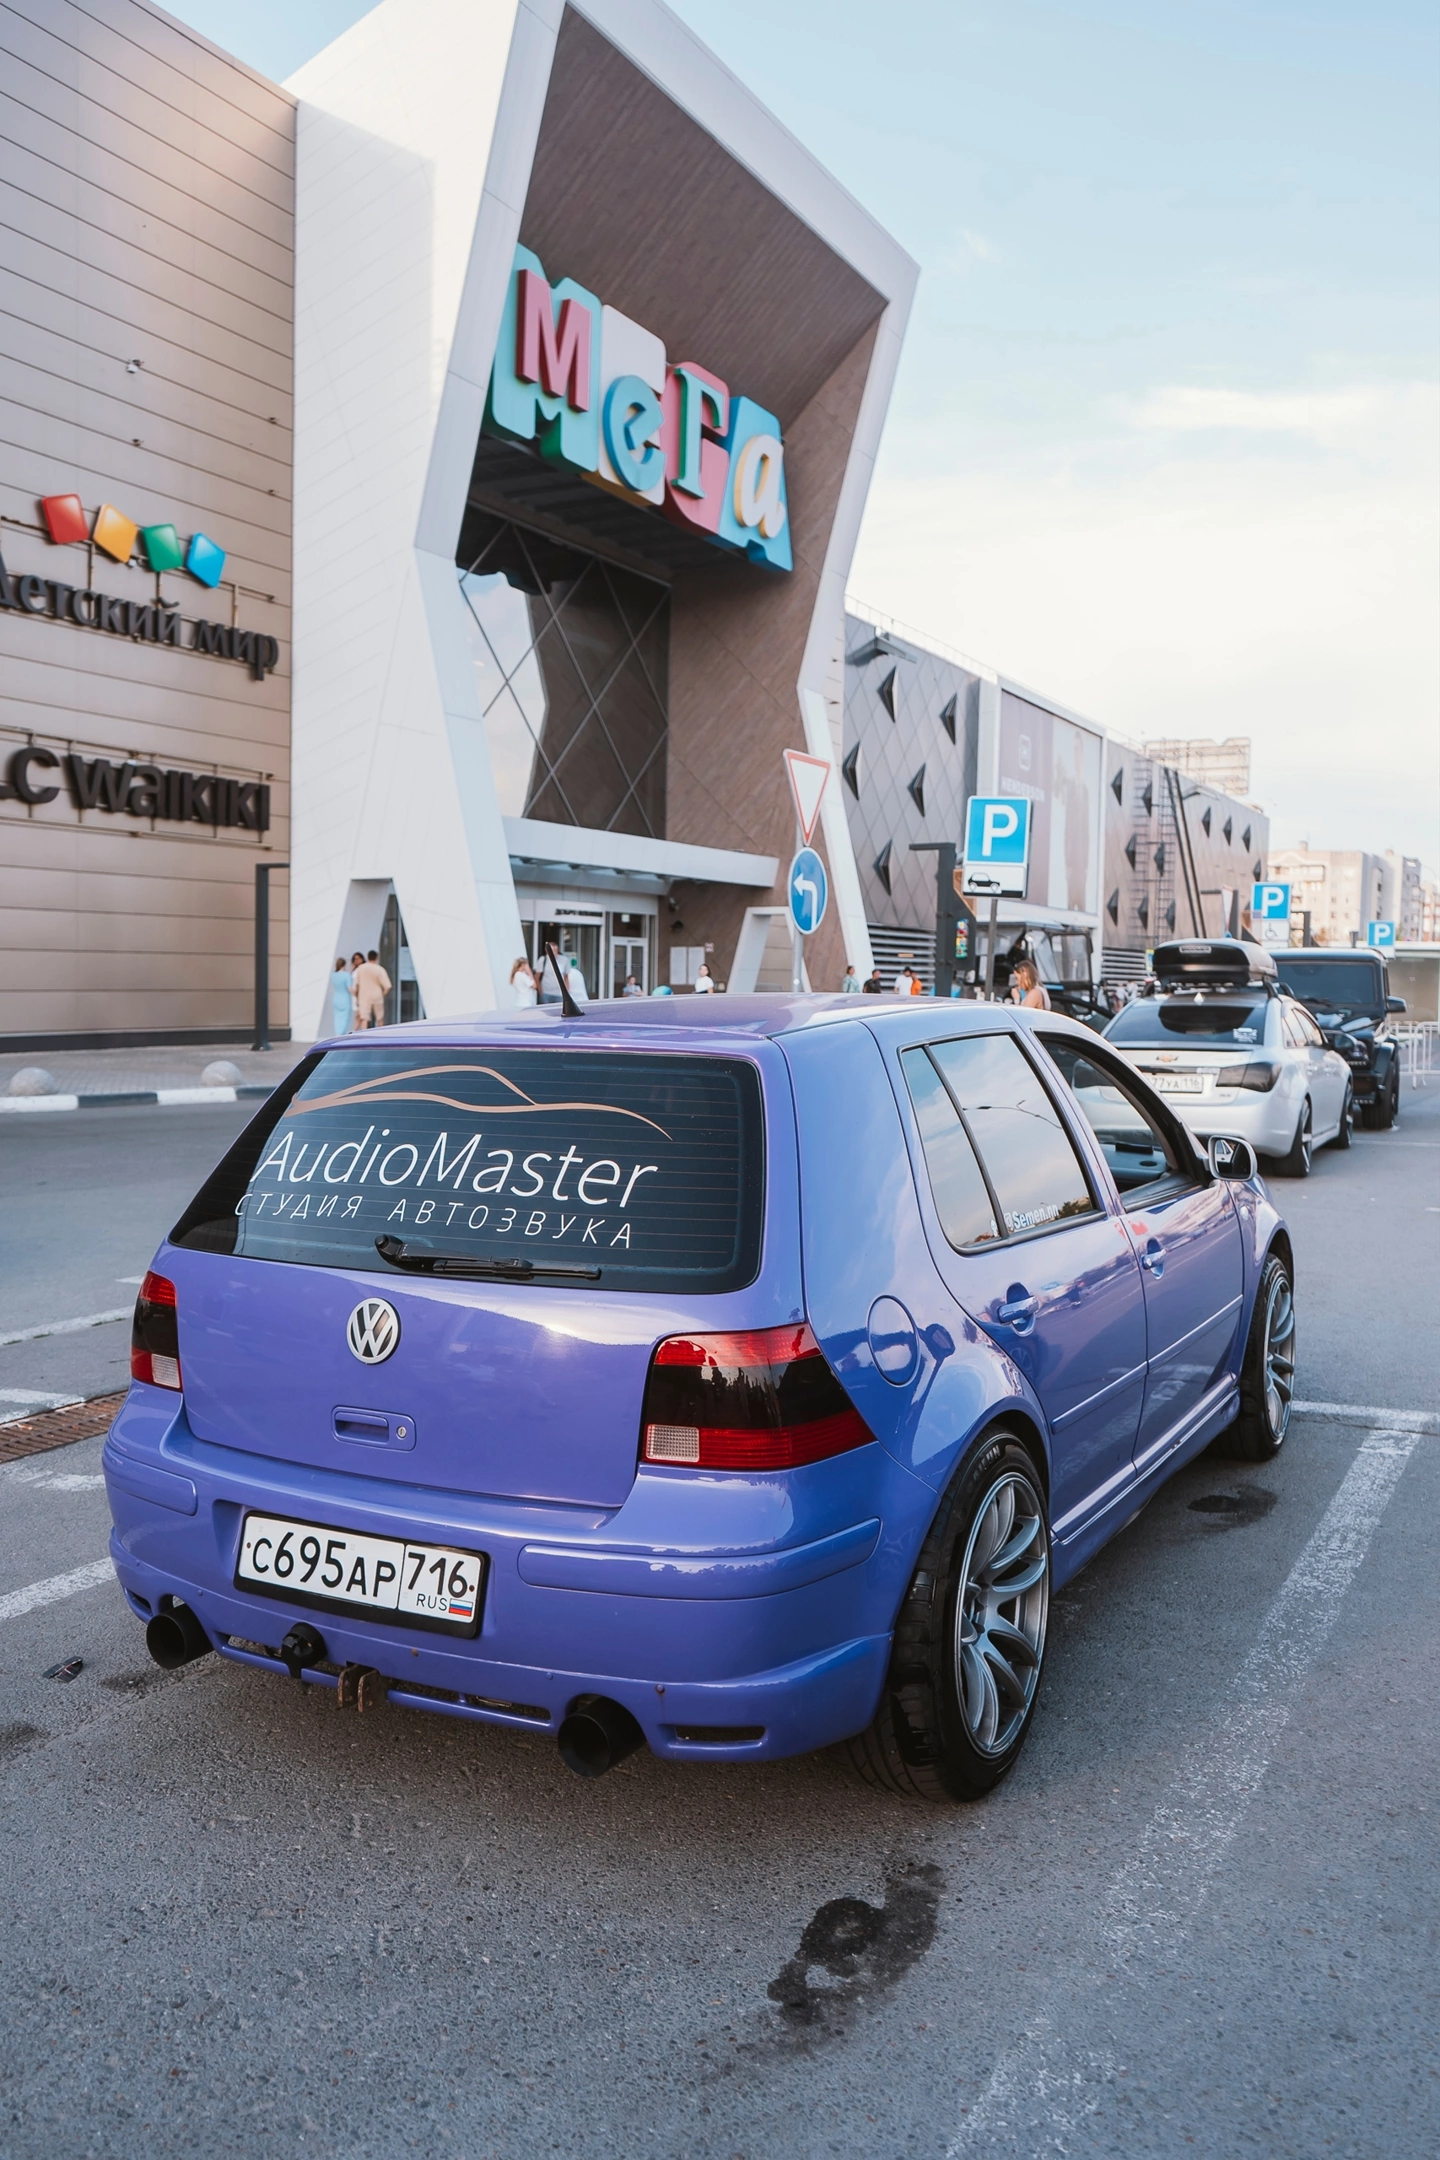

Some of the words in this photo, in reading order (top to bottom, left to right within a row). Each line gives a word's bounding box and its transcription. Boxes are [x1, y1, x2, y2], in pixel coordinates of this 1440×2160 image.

[194, 621, 280, 681] мир
[0, 747, 61, 803] C
[982, 805, 1019, 856] P
[1261, 886, 1285, 917] P
[1374, 924, 1391, 945] P
[249, 1125, 658, 1208] AudioMaster
[234, 1193, 363, 1219] СТУДИЯ
[387, 1199, 632, 1249] АВТОЗВУКА
[408, 1552, 468, 1598] 716
[416, 1594, 448, 1611] RUS
